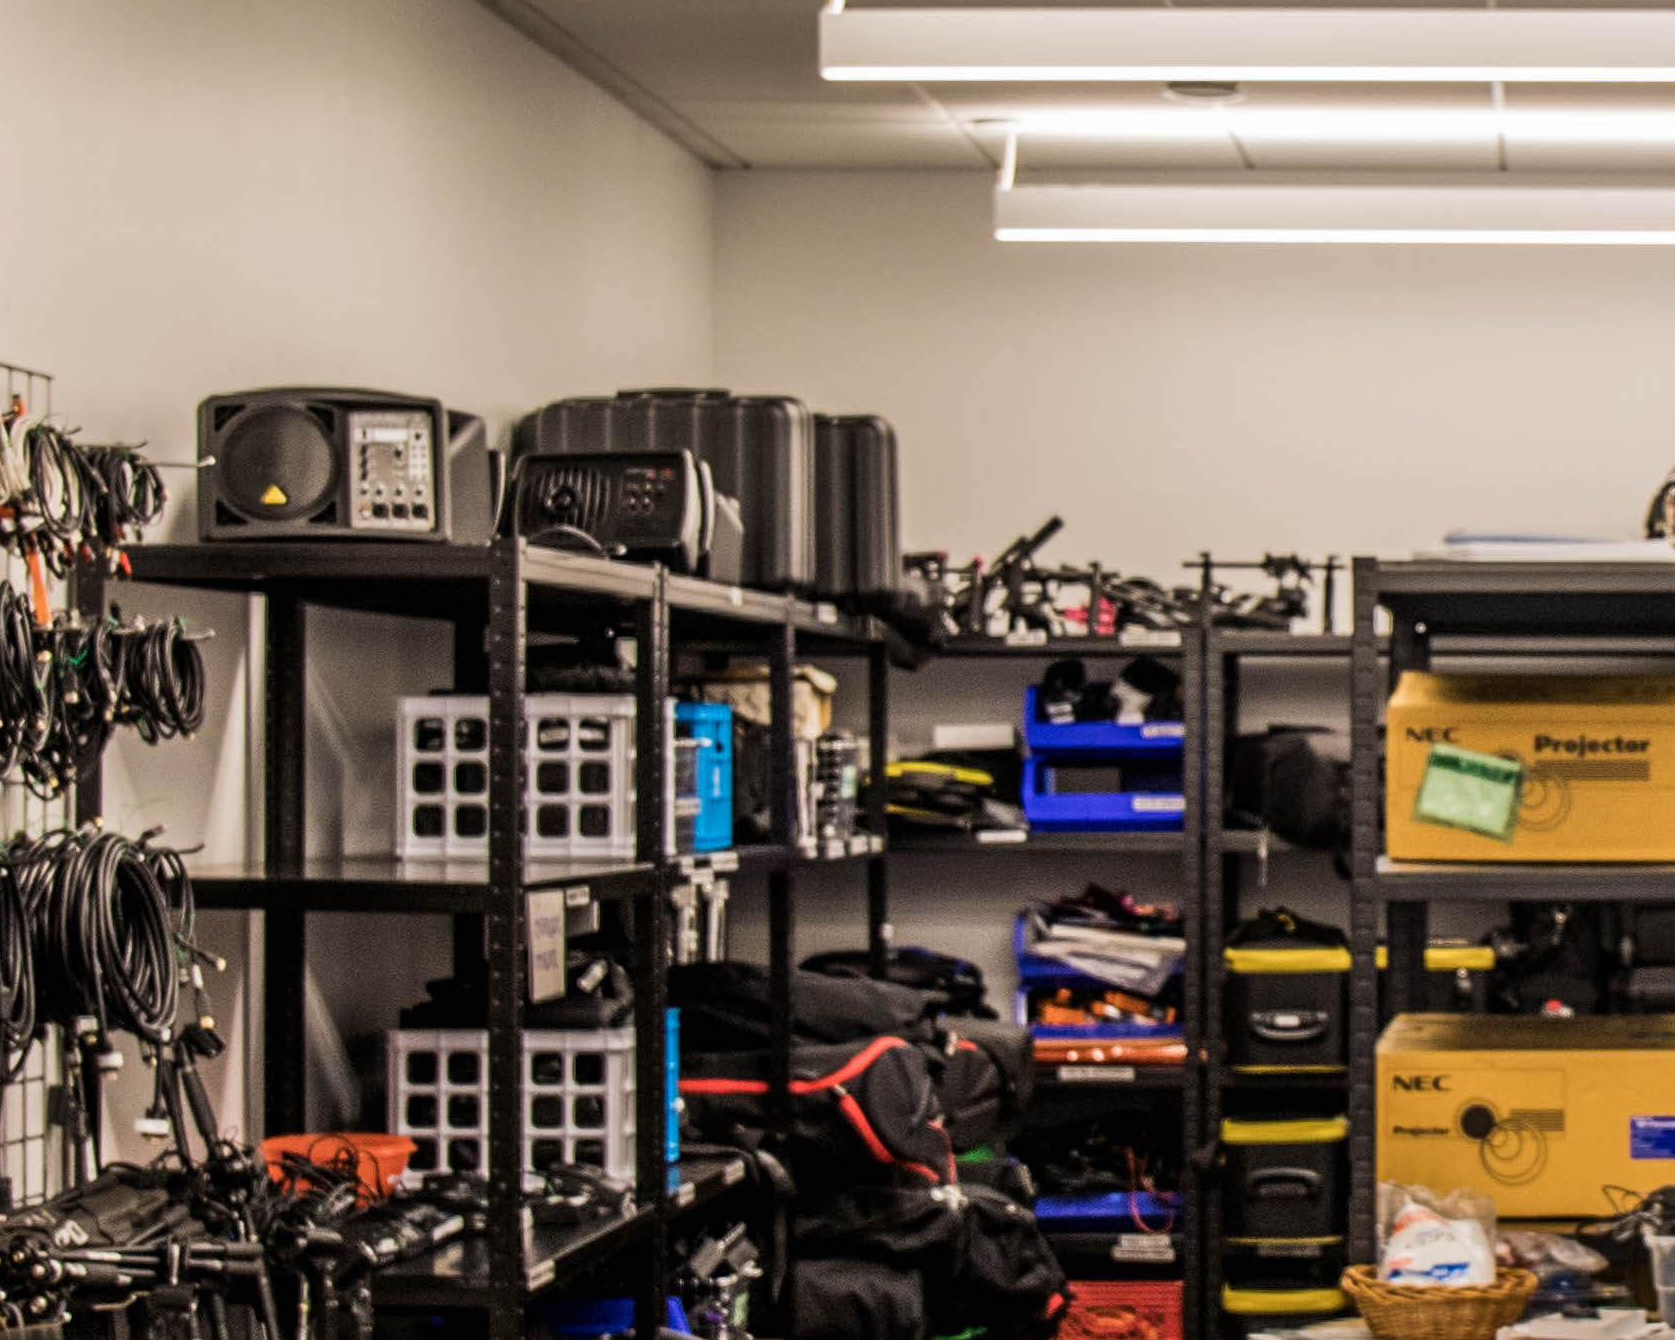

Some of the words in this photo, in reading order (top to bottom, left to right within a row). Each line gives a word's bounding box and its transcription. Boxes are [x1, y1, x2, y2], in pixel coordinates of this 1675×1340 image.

[1406, 726, 1460, 744] NEC
[1534, 734, 1650, 759] Projector
[1392, 1074, 1451, 1092] NEC
